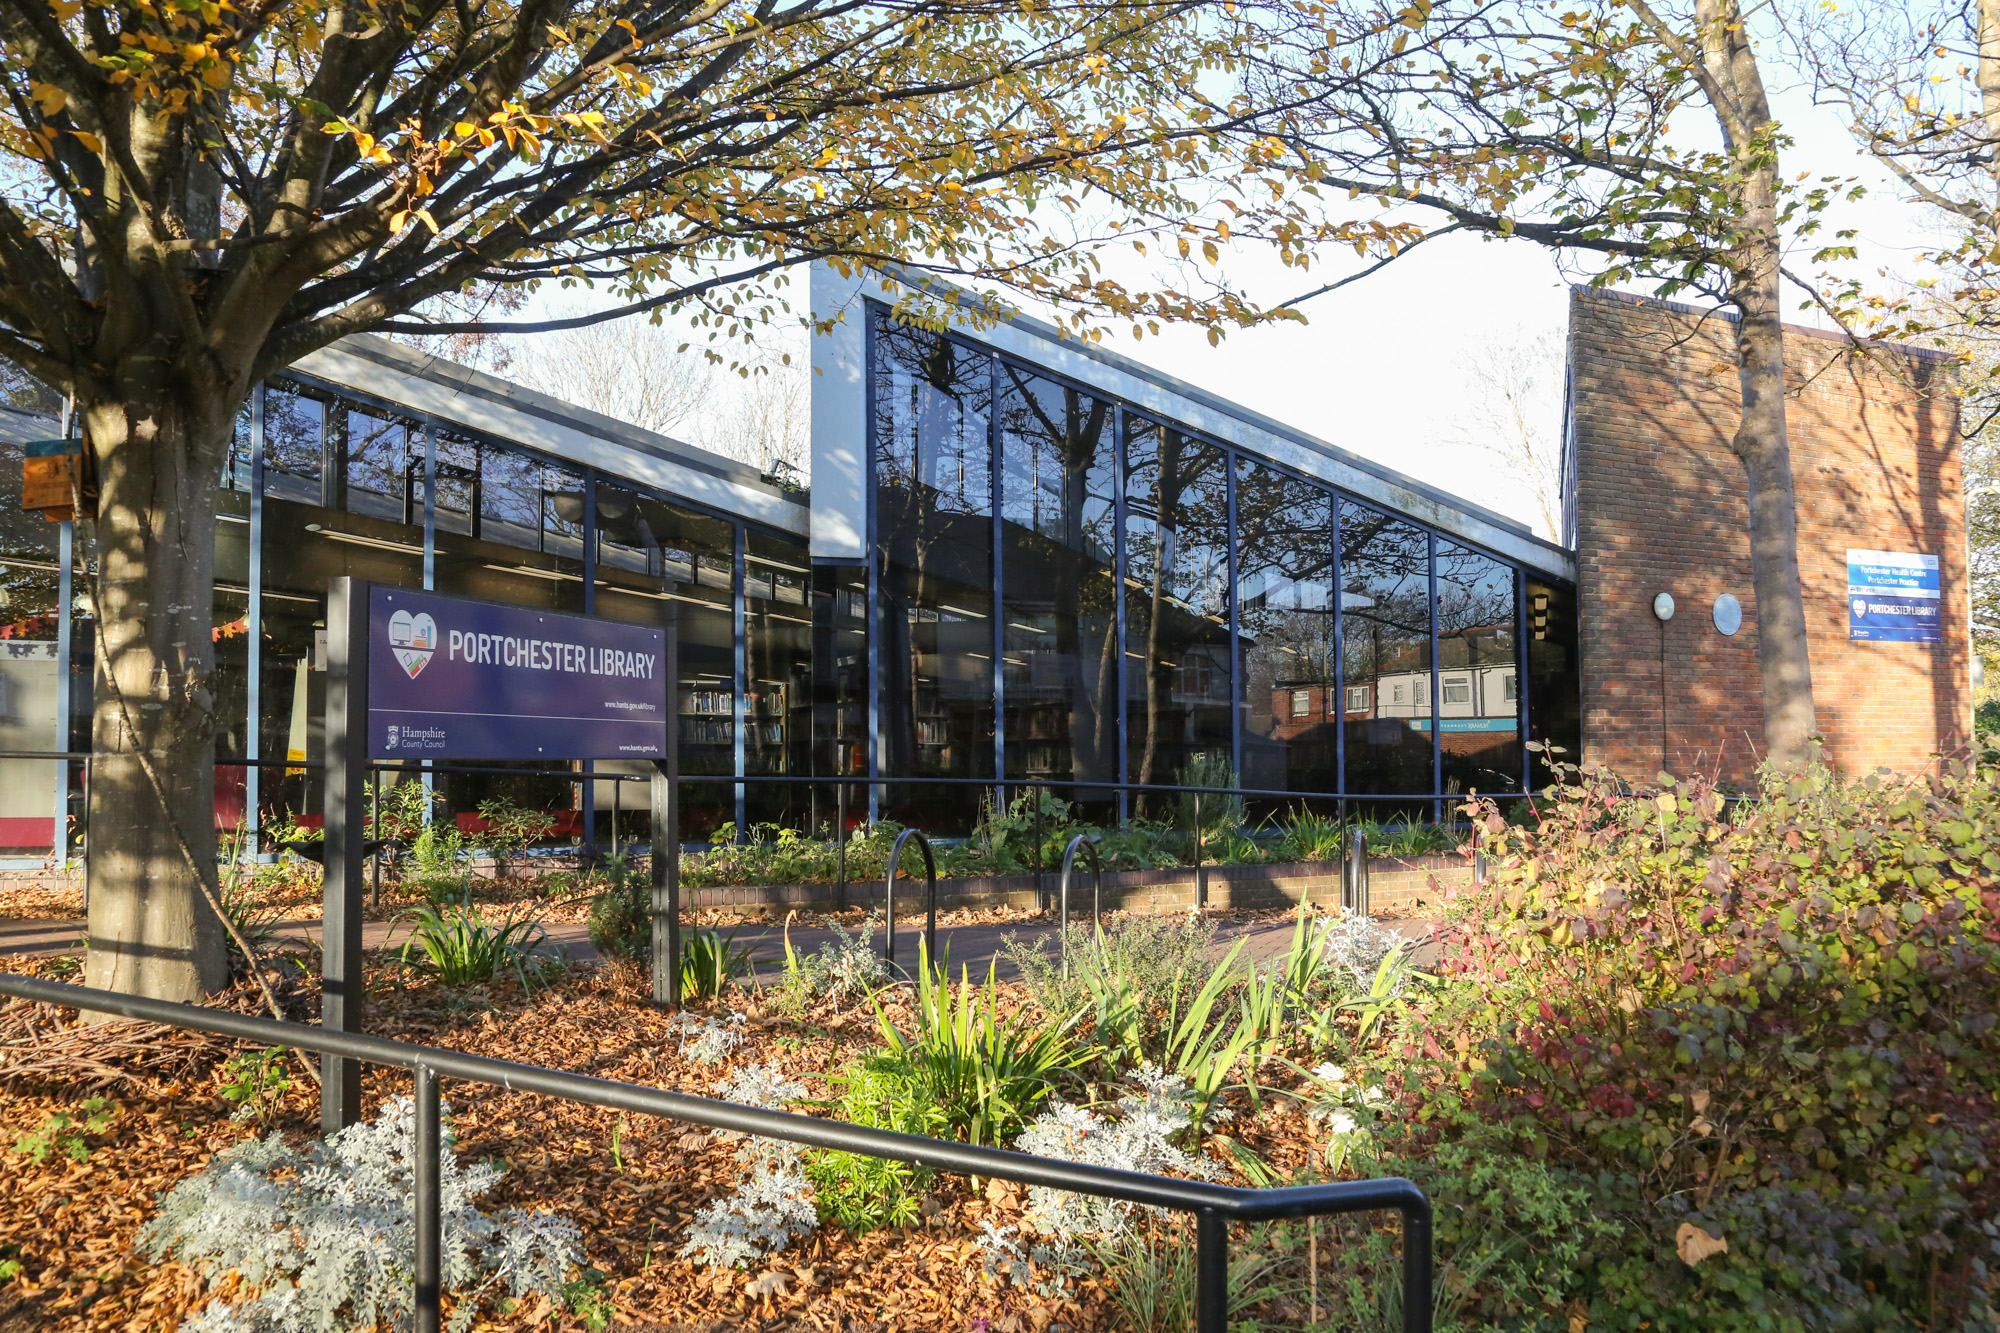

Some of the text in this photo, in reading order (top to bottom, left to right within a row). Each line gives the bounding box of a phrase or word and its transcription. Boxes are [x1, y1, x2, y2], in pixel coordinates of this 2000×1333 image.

[1860, 566, 1927, 577] Portchester Health Centre
[1867, 576, 1919, 586] Portchester Practice
[1868, 603, 1937, 616] PORTCHESTER LIBRARY
[449, 629, 656, 679] PORTCHESTER LIBRARY
[401, 725, 446, 741] Hampshire
[401, 739, 446, 750] County Council
